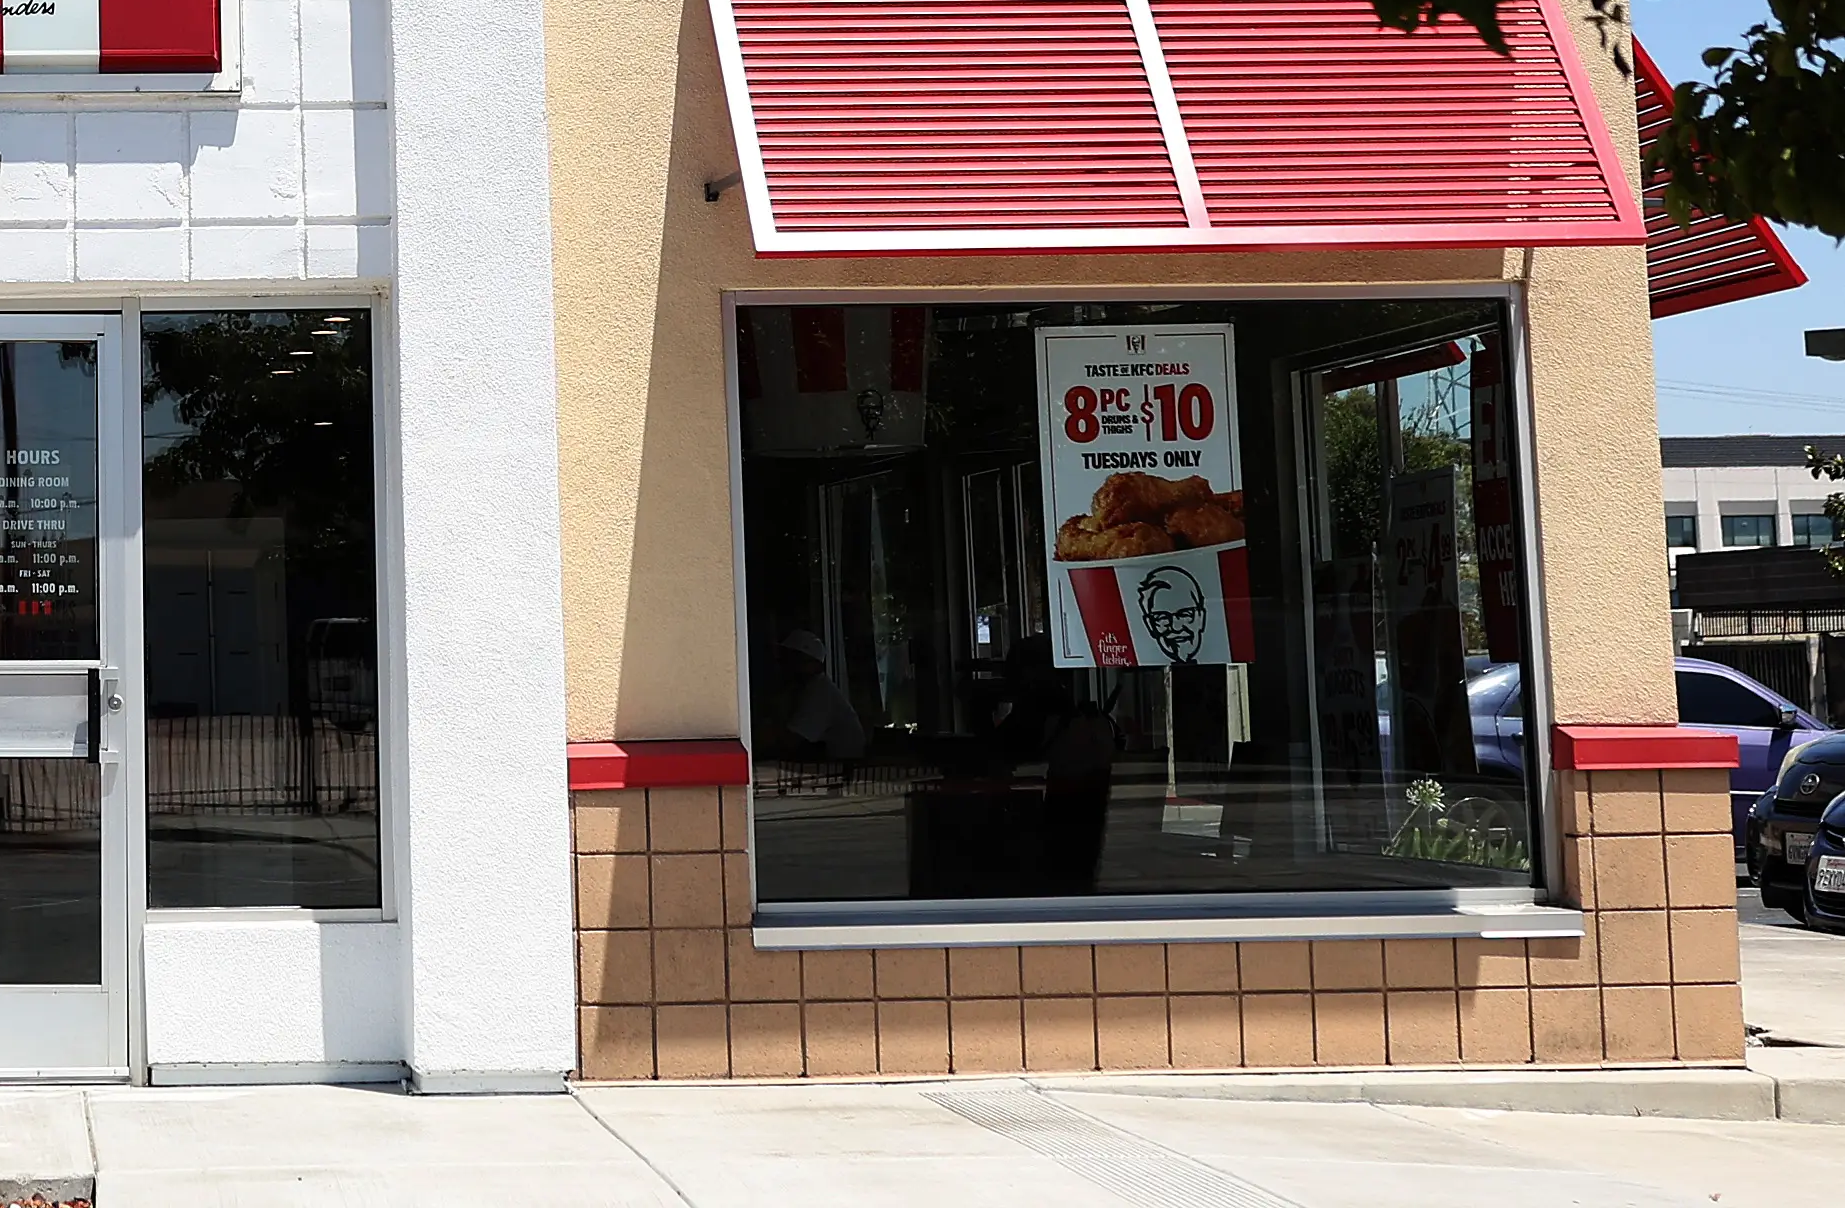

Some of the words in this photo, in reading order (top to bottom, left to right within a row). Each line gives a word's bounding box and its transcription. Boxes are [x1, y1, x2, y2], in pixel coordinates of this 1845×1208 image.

[1084, 365, 1118, 378] TASTE
[1130, 364, 1154, 377] KFC
[1155, 363, 1190, 376] DEALS
[1064, 385, 1100, 443] 8
[1100, 388, 1131, 413] PC
[1140, 383, 1215, 442] $10
[1101, 415, 1131, 425] DRUMS
[1132, 414, 1139, 424] &
[1101, 425, 1133, 435] THIGHS
[6, 449, 60, 465] HOURS
[1081, 451, 1158, 469] TUESDAYS
[1163, 450, 1202, 468] ONLY
[38, 476, 69, 487] ROOM
[30, 498, 57, 509] 10:00
[60, 500, 81, 512] p.m.
[2, 520, 35, 531] DRIVE
[36, 519, 66, 530] THRU
[10, 540, 26, 549] SUN
[33, 540, 57, 549] THURS
[32, 553, 57, 564] 11:00
[59, 554, 80, 566] p.m.
[19, 569, 31, 578] FRI
[37, 569, 51, 578] SAT
[31, 582, 56, 593] 11:00
[58, 584, 80, 596] p.m.
[1098, 639, 1128, 657] finger
